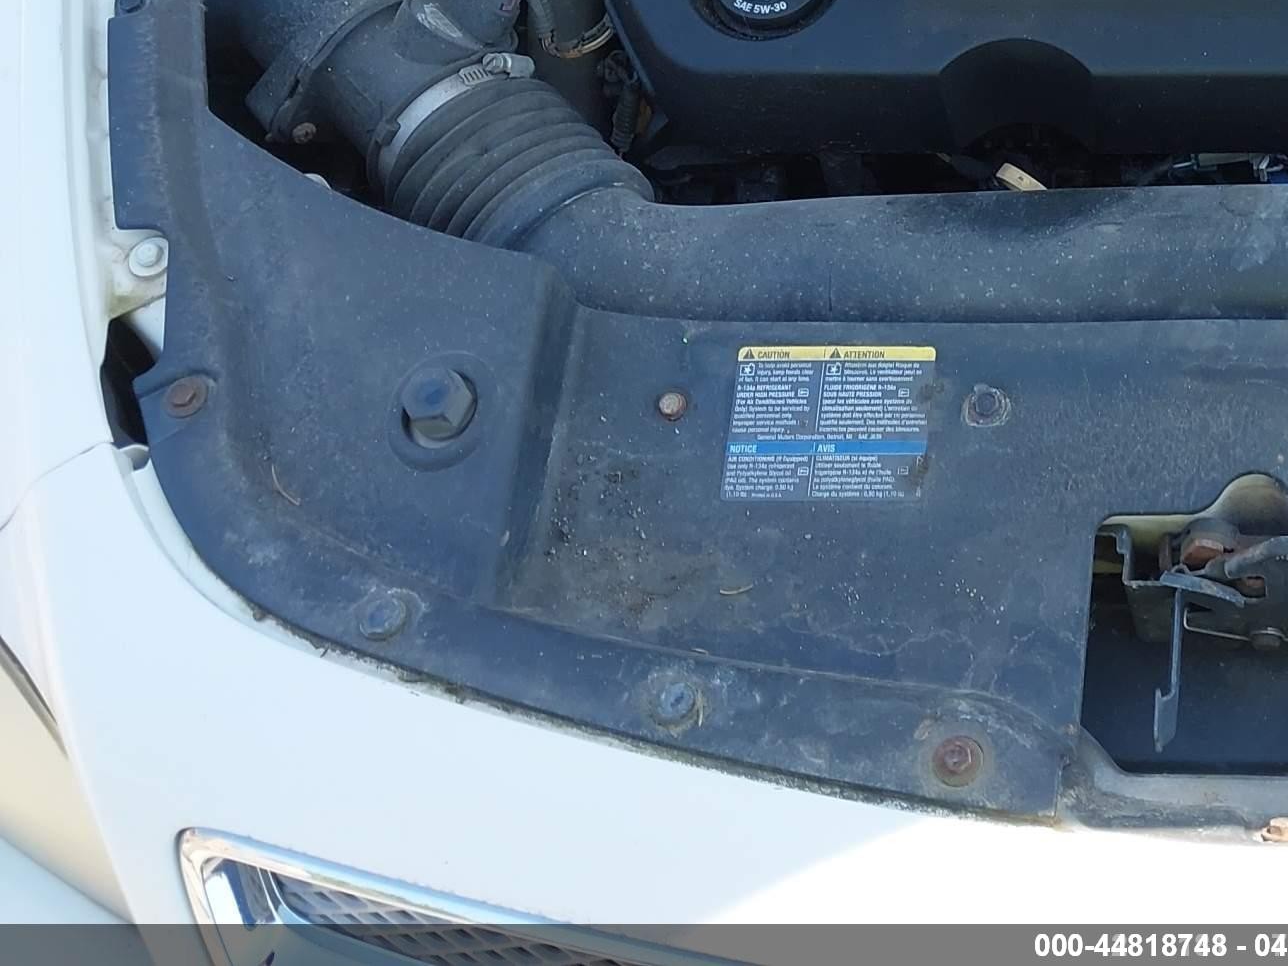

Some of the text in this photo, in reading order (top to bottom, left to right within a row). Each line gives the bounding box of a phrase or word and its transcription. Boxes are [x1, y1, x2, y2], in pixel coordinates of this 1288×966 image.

[753, 1, 787, 14] 5W-30
[757, 351, 791, 359] CAUTION
[844, 351, 885, 359] ATTENTION
[730, 445, 758, 453] NOTICE
[817, 444, 836, 452] AVIS
